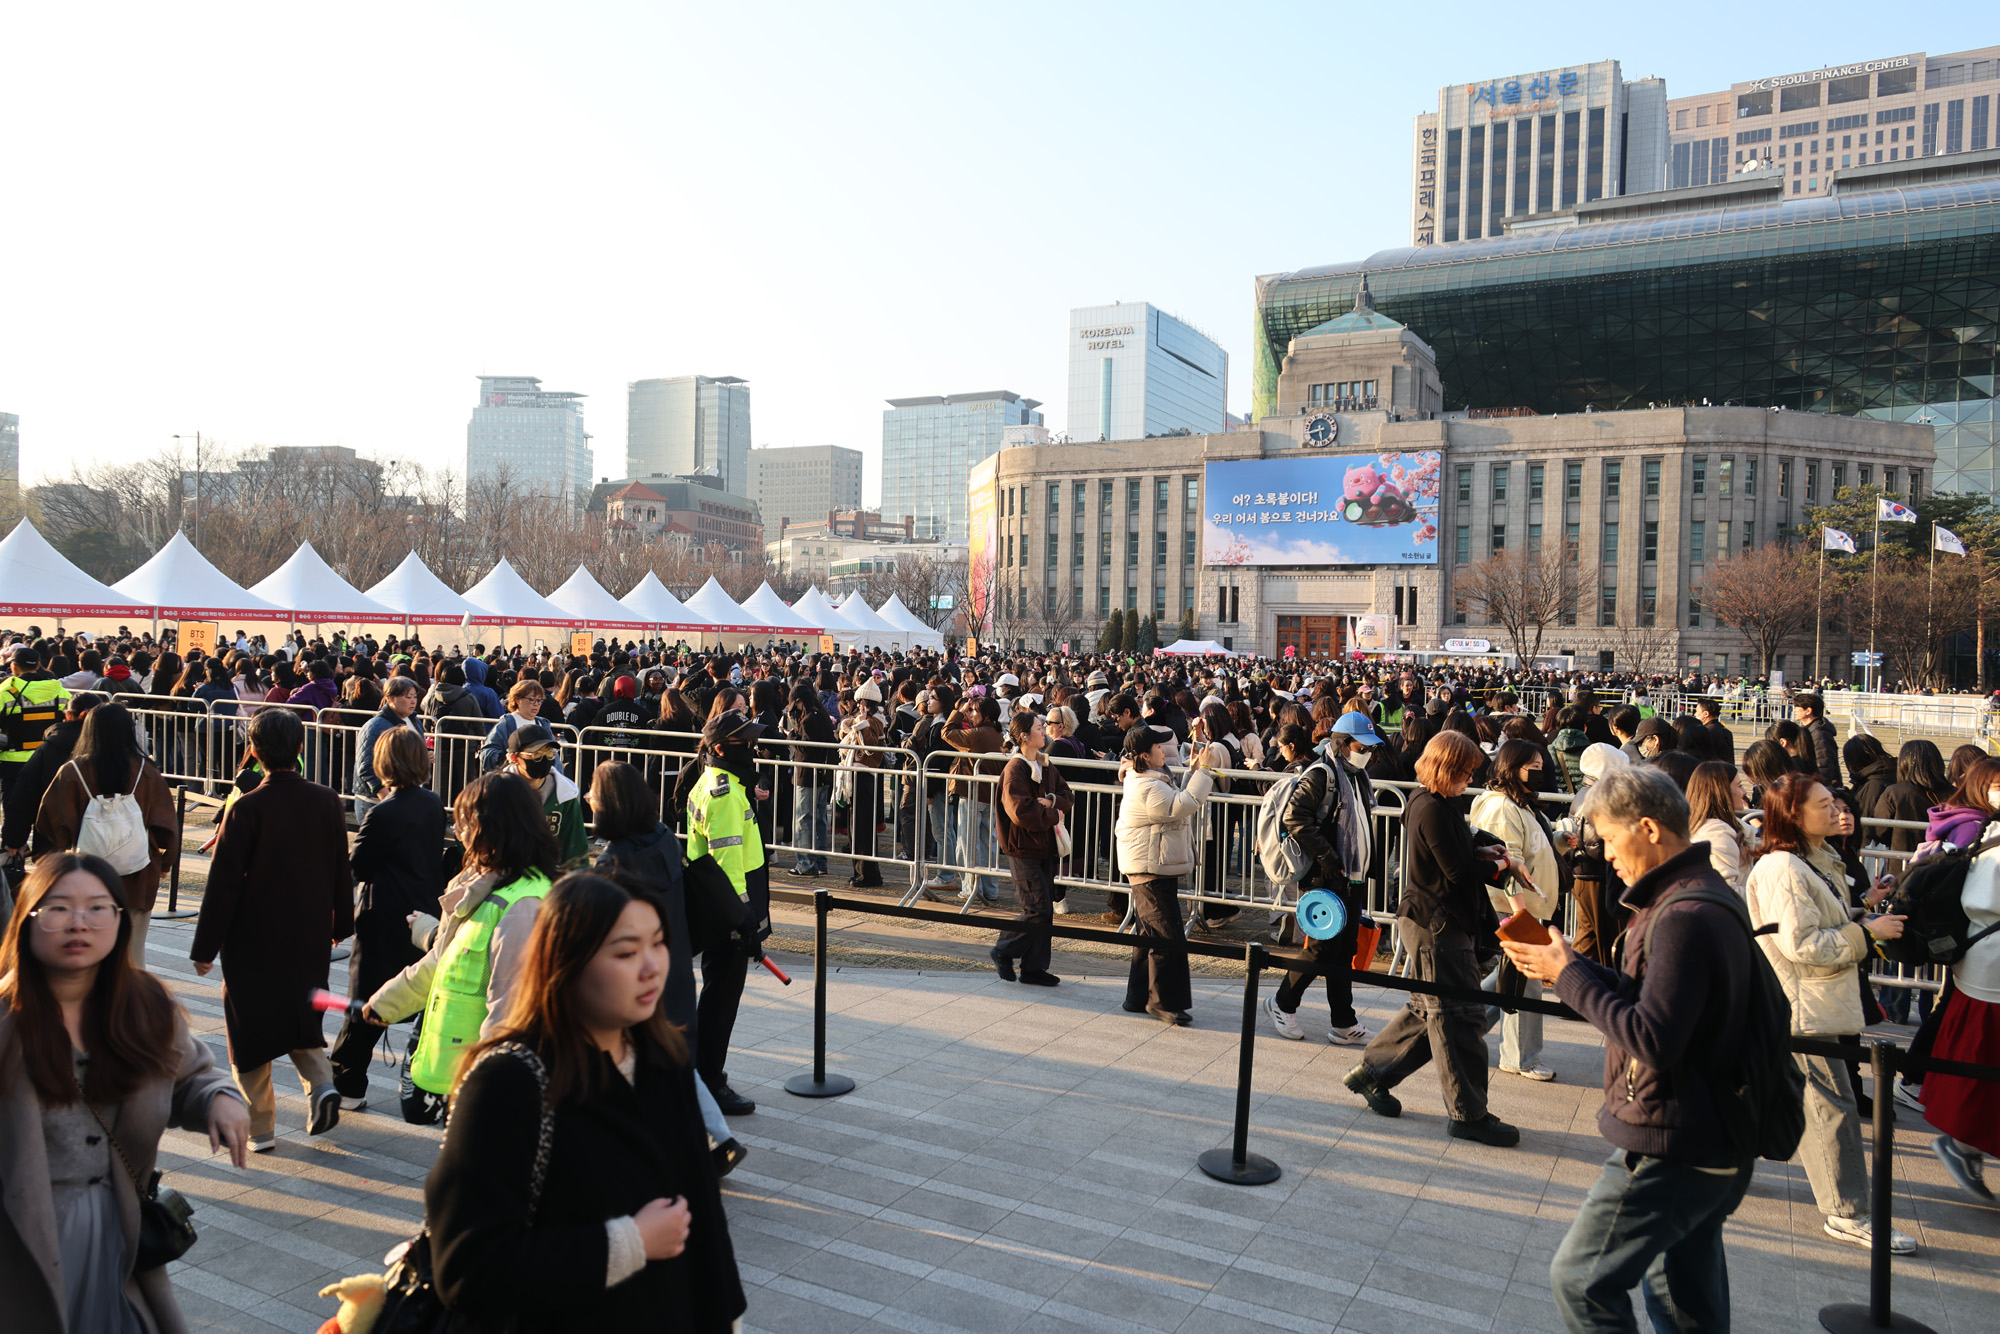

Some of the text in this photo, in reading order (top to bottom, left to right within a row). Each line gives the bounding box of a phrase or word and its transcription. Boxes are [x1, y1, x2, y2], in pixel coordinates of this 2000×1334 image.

[1771, 76, 1809, 88] SEOUL
[1812, 64, 1862, 81] FINANCE
[1865, 57, 1909, 72] CENTER
[1473, 72, 1579, 106] 서울신문
[1489, 99, 1557, 118] seoul.co.kr
[1080, 325, 1134, 339] KOREANA
[1087, 339, 1124, 350] HOTEL
[1232, 491, 1318, 507] 어? 초록불이다!
[1212, 510, 1340, 525] 우리 어서 봄으로 건너가요
[190, 630, 205, 639] BTS
[606, 711, 639, 723] DOUBLE UP
